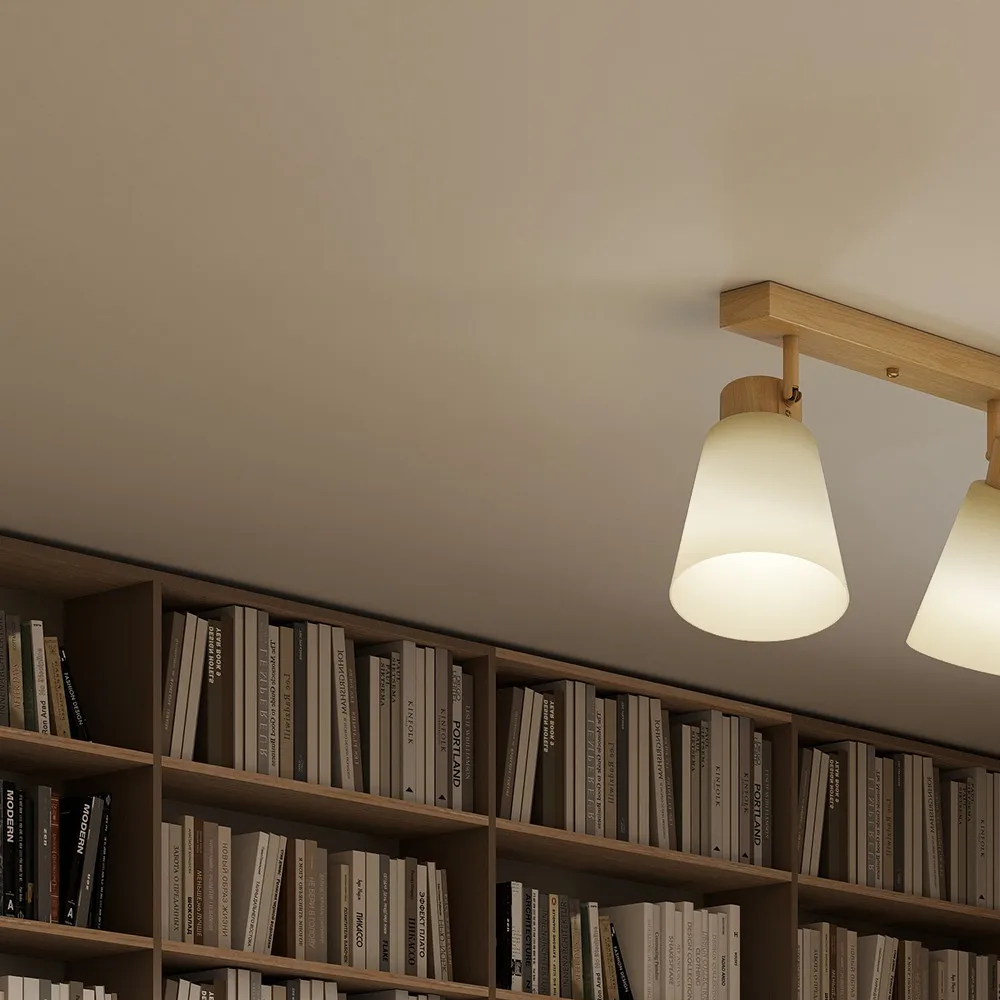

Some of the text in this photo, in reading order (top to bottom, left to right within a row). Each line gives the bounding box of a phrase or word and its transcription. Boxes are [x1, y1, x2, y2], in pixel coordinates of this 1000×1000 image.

[64, 672, 83, 725] FASHION DESIGN
[77, 804, 90, 854] MODERN
